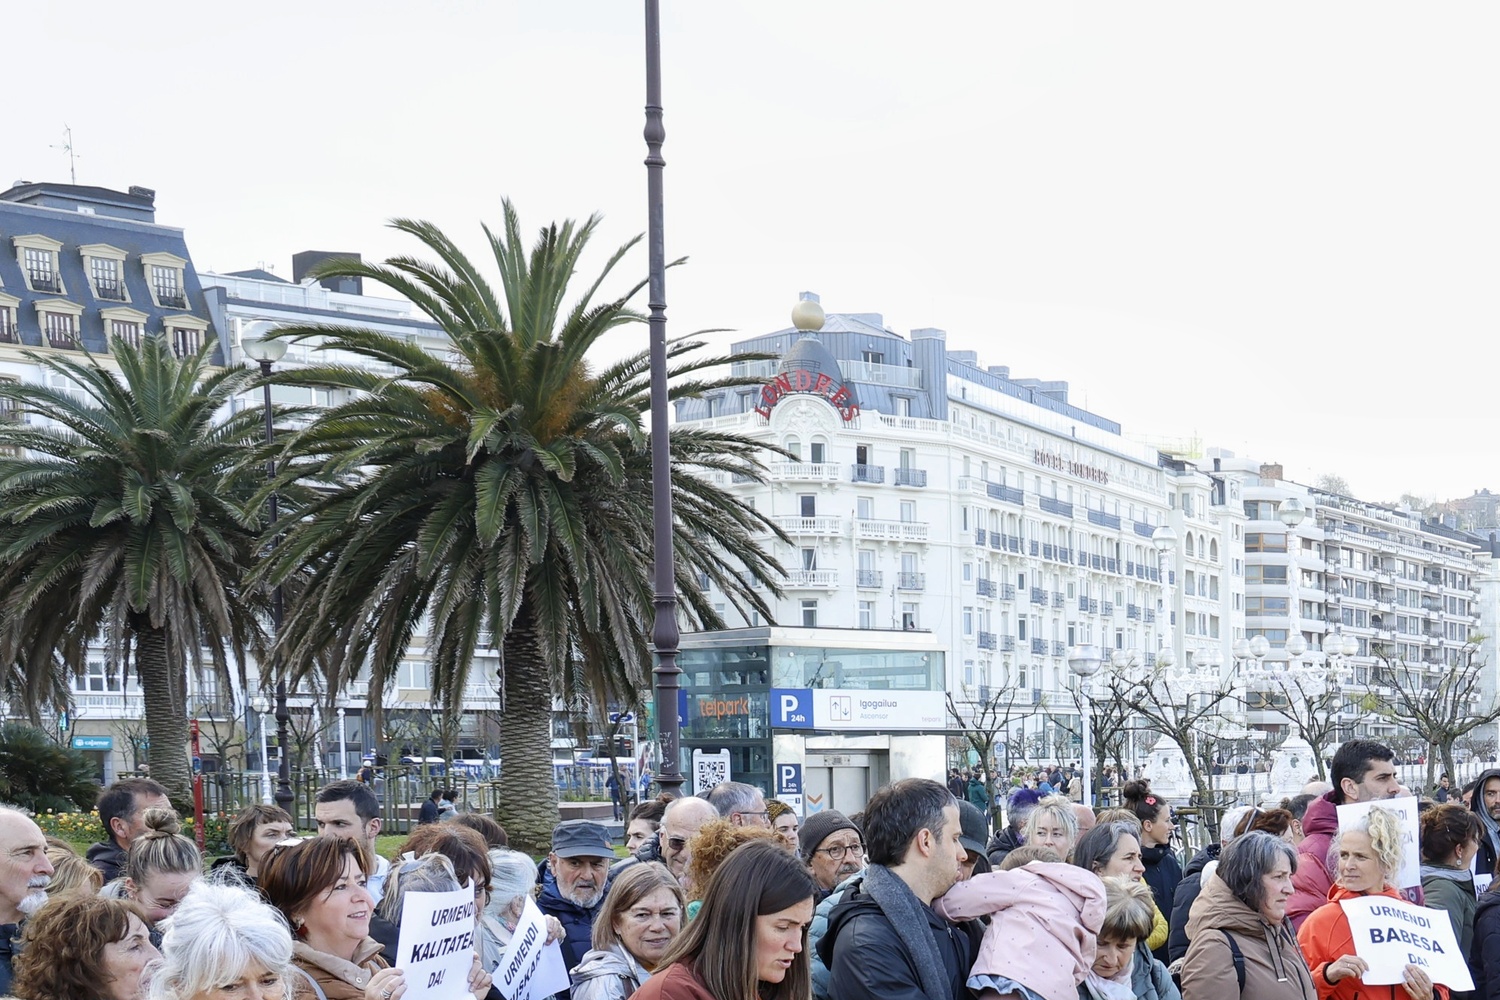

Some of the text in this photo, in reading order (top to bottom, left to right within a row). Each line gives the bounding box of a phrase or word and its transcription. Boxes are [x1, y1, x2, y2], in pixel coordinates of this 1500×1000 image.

[755, 368, 861, 422] LONDRES
[1034, 448, 1109, 485] HOTEL LONDRES
[700, 697, 750, 720] telpark
[780, 694, 806, 722] P 24h
[859, 699, 898, 709] Igogailua
[859, 712, 888, 720] Ascensor
[781, 765, 796, 788] P
[431, 901, 474, 927] URMEND
[1369, 905, 1432, 929] URMENDI
[410, 930, 475, 963] KALITATEA
[504, 921, 539, 986] URMENDI
[1369, 927, 1445, 955] BABESA
[1407, 952, 1430, 968] DA!
[427, 968, 446, 989] DA!
